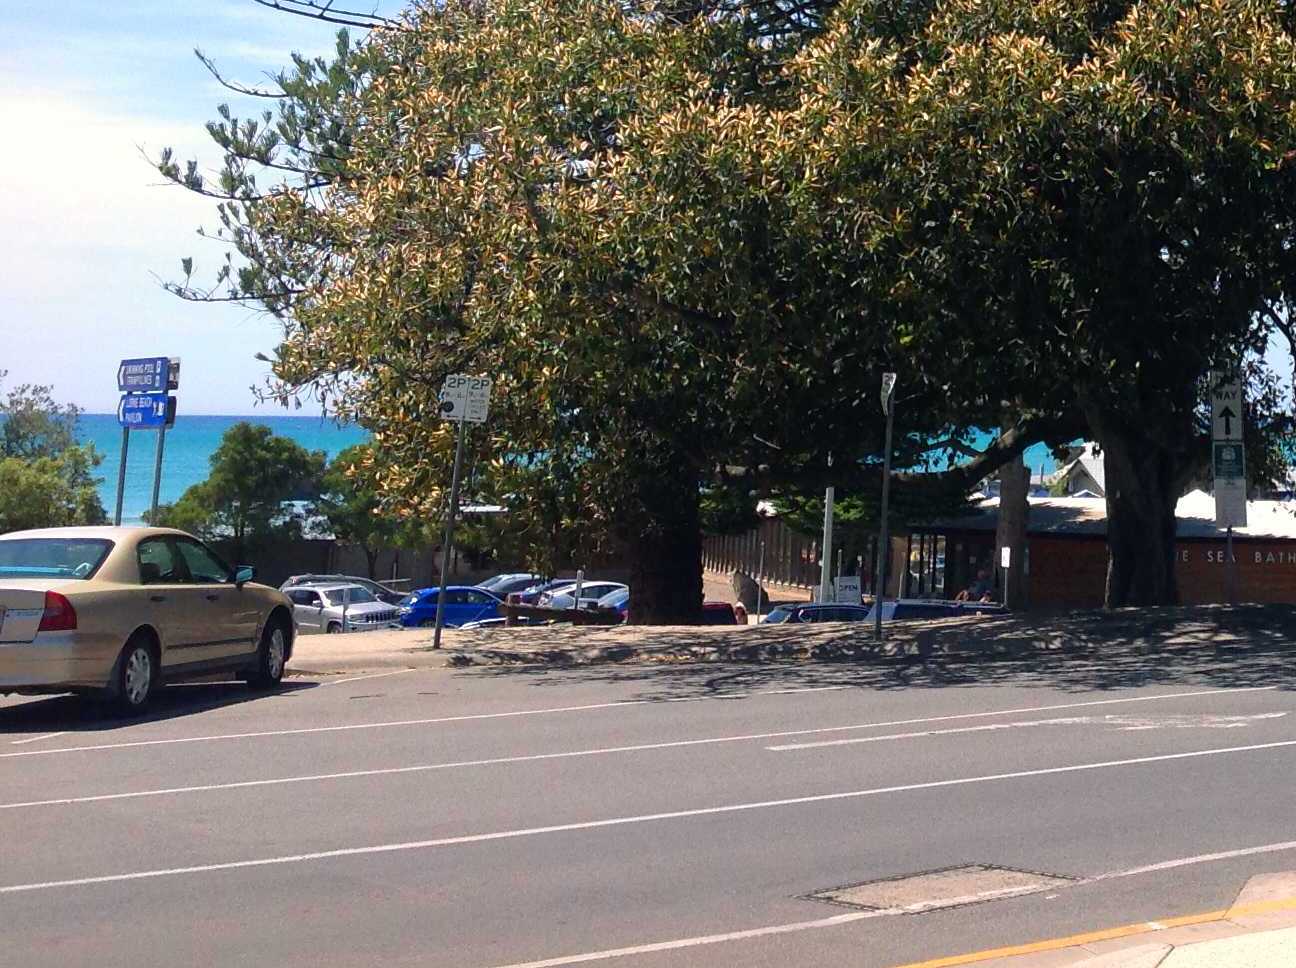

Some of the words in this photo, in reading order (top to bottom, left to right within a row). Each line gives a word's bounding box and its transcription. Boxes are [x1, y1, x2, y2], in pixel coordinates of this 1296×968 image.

[447, 377, 466, 389] 2P
[471, 378, 490, 390] 2P
[1214, 390, 1237, 401] WAY
